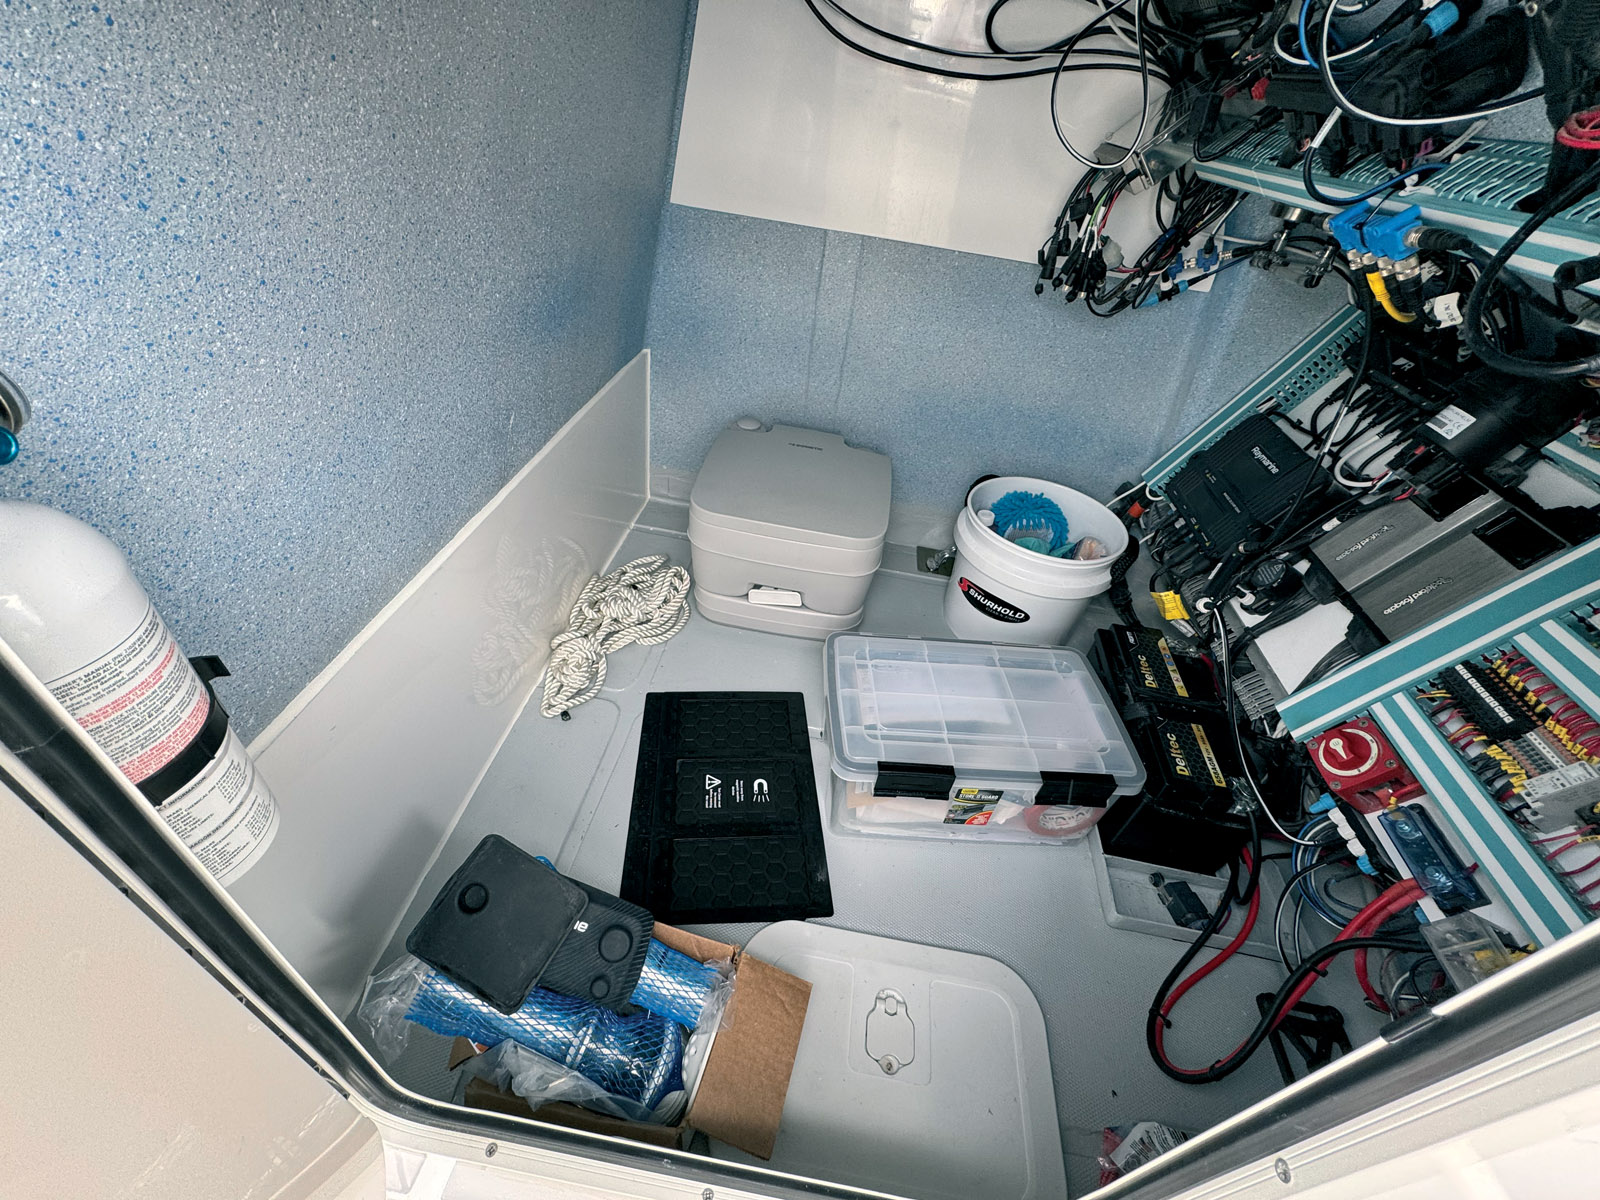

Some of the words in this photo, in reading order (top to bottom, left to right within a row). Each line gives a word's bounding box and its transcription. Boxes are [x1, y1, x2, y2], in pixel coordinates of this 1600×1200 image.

[1251, 446, 1280, 475] Raymarine
[969, 588, 1025, 619] SHURHOLD
[68, 684, 99, 701] property
[98, 668, 124, 687] damage.
[77, 673, 107, 692] Improper
[108, 667, 118, 676] use
[82, 660, 110, 678] MANUAL
[83, 671, 102, 684] READ
[101, 664, 113, 674] ALL
[1138, 654, 1158, 688] Deltec
[1167, 732, 1189, 776] Deltec
[167, 774, 206, 806] INFORMATION
